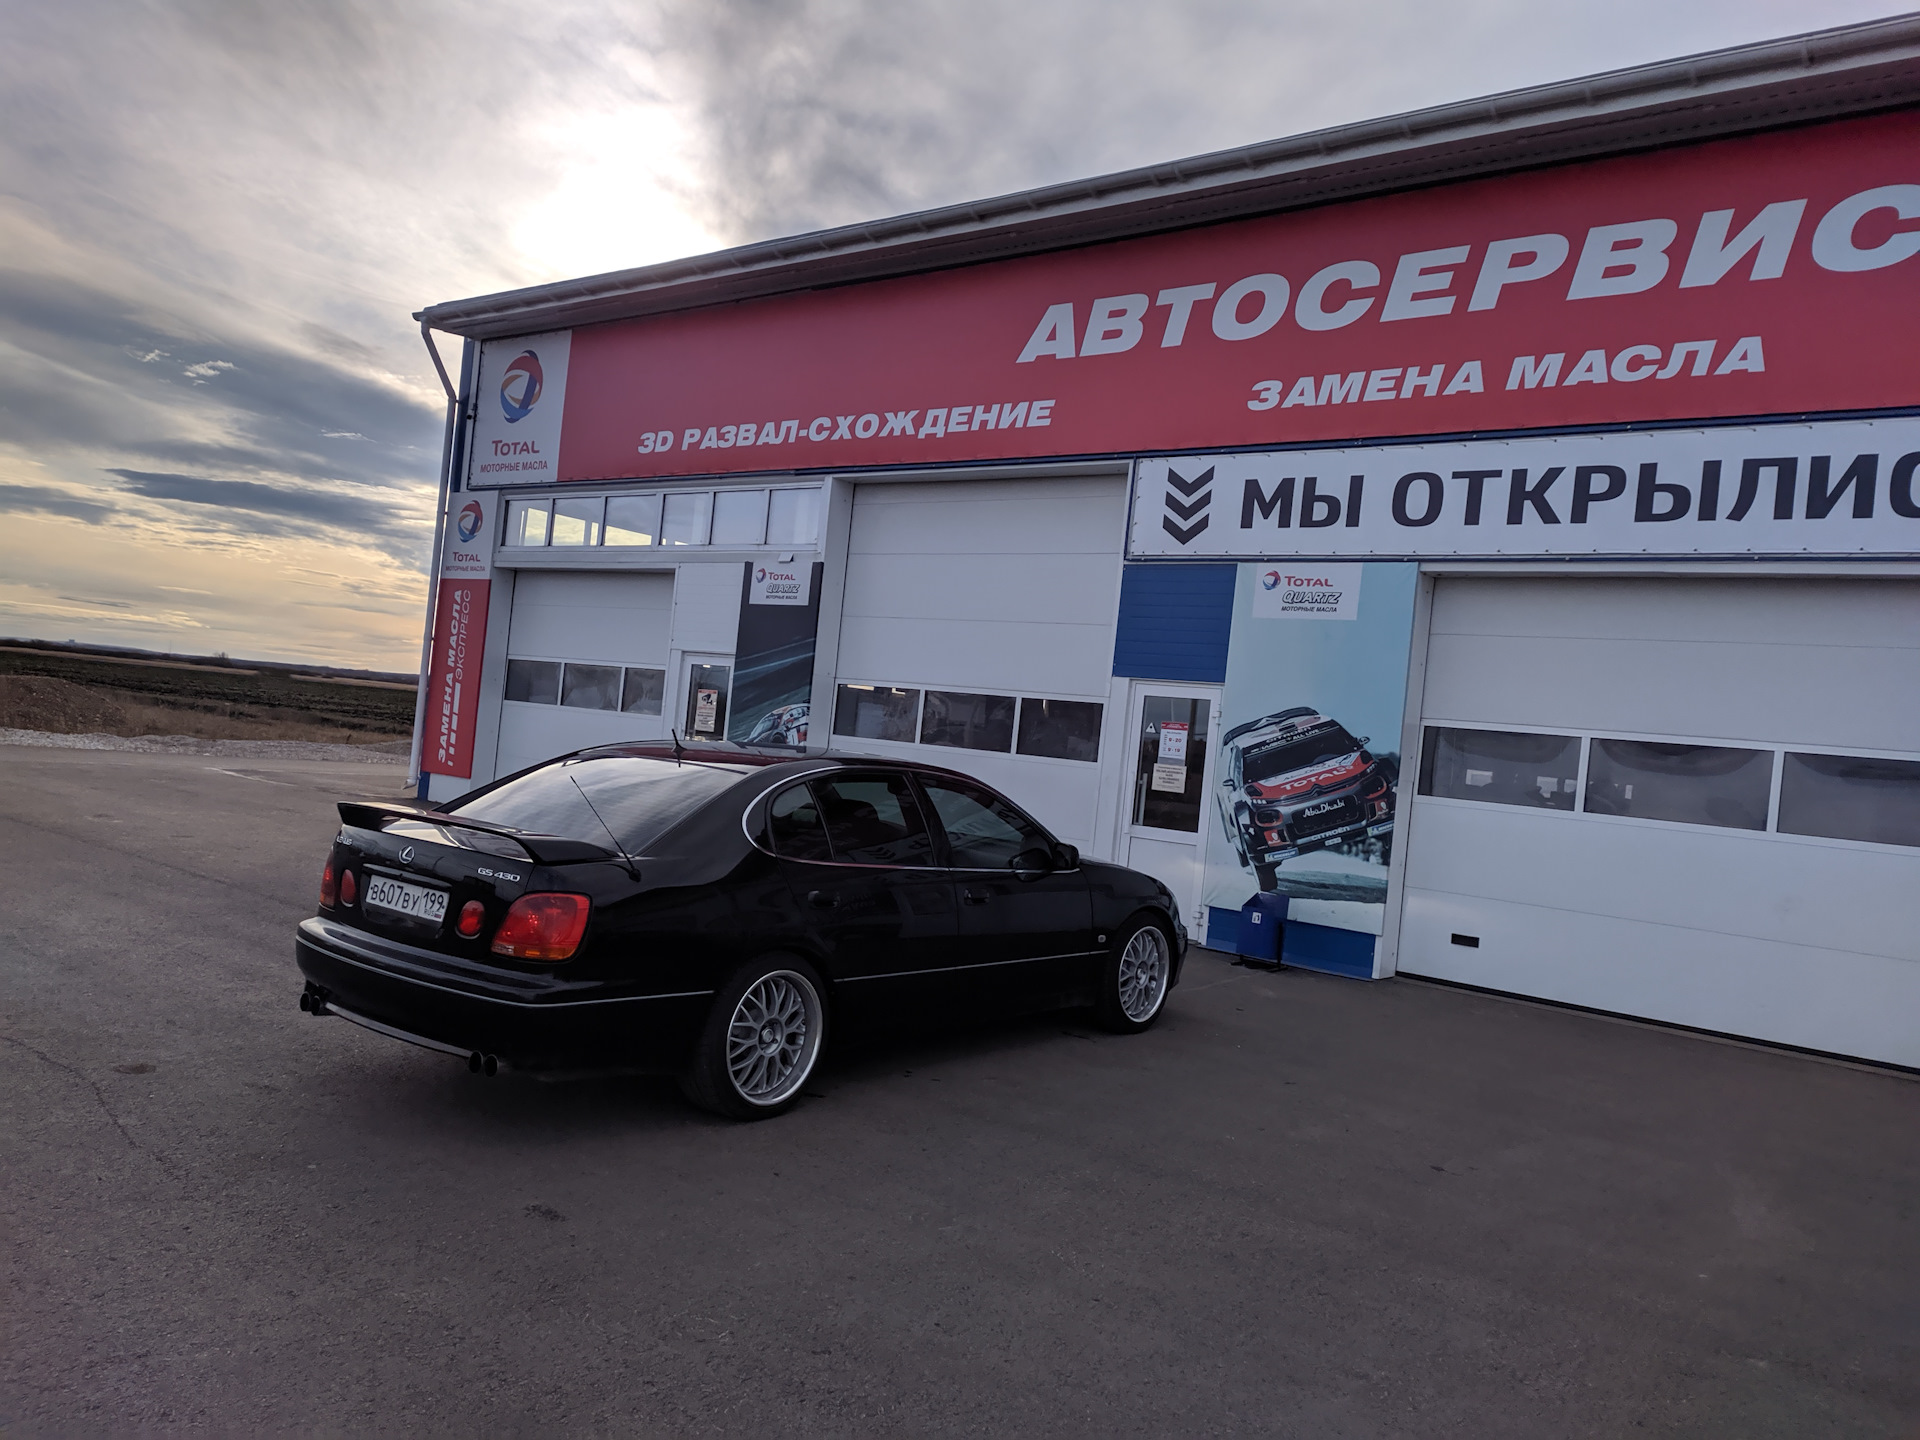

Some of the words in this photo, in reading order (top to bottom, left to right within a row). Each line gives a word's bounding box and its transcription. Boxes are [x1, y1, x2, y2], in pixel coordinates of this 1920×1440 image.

[1016, 184, 1920, 363] АВТОСЕРВИС
[1247, 360, 1484, 411] ЗАМЕНА
[1505, 336, 1765, 391] МАСЛА
[638, 430, 674, 454] 3D
[681, 399, 1056, 451] РАЗВАЛ-СХОЖДЕНИЕ
[492, 440, 540, 456] TOTAL
[480, 462, 520, 472] МОТОРНЫЕ
[522, 460, 547, 470] МАСЛА
[1240, 475, 1363, 529] МЫ
[453, 552, 481, 562] TOTAL
[768, 572, 796, 580] TOTAL
[1284, 576, 1334, 587] TOTAL
[766, 583, 800, 593] QUARTZ
[1282, 590, 1342, 604] QUARTZ
[455, 589, 471, 680] ЭКСПРЕСС
[438, 672, 453, 763] ЗАМЕНА
[447, 589, 463, 667] МАСЛА
[1280, 769, 1347, 790] TOTAL
[478, 867, 493, 877] GS
[494, 871, 521, 882] 430
[371, 882, 420, 911] В607ВУ
[423, 891, 445, 912] 199
[424, 908, 435, 917] RUS
